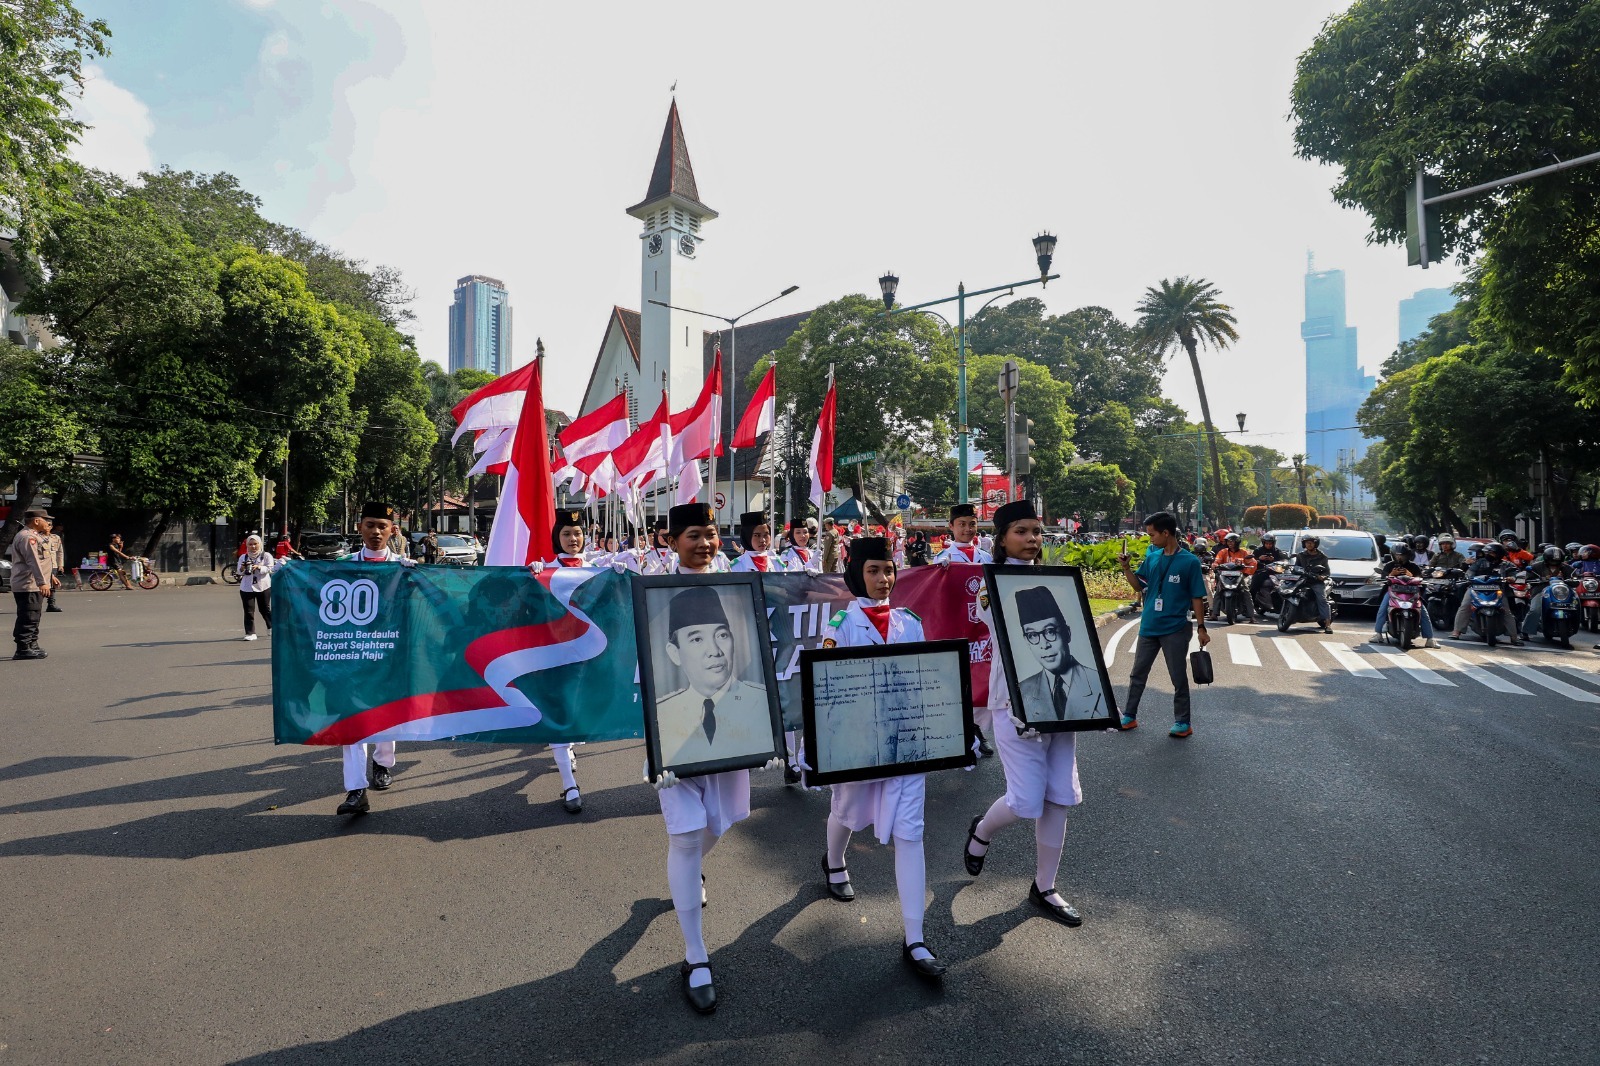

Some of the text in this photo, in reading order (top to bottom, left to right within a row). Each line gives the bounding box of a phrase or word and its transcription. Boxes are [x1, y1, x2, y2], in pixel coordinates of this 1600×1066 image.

[319, 578, 379, 626] 80
[316, 630, 400, 640] Bersatu Berdaulat
[315, 641, 395, 651] Rakyat Sejahtera
[314, 651, 384, 662] Indonesia Maju
